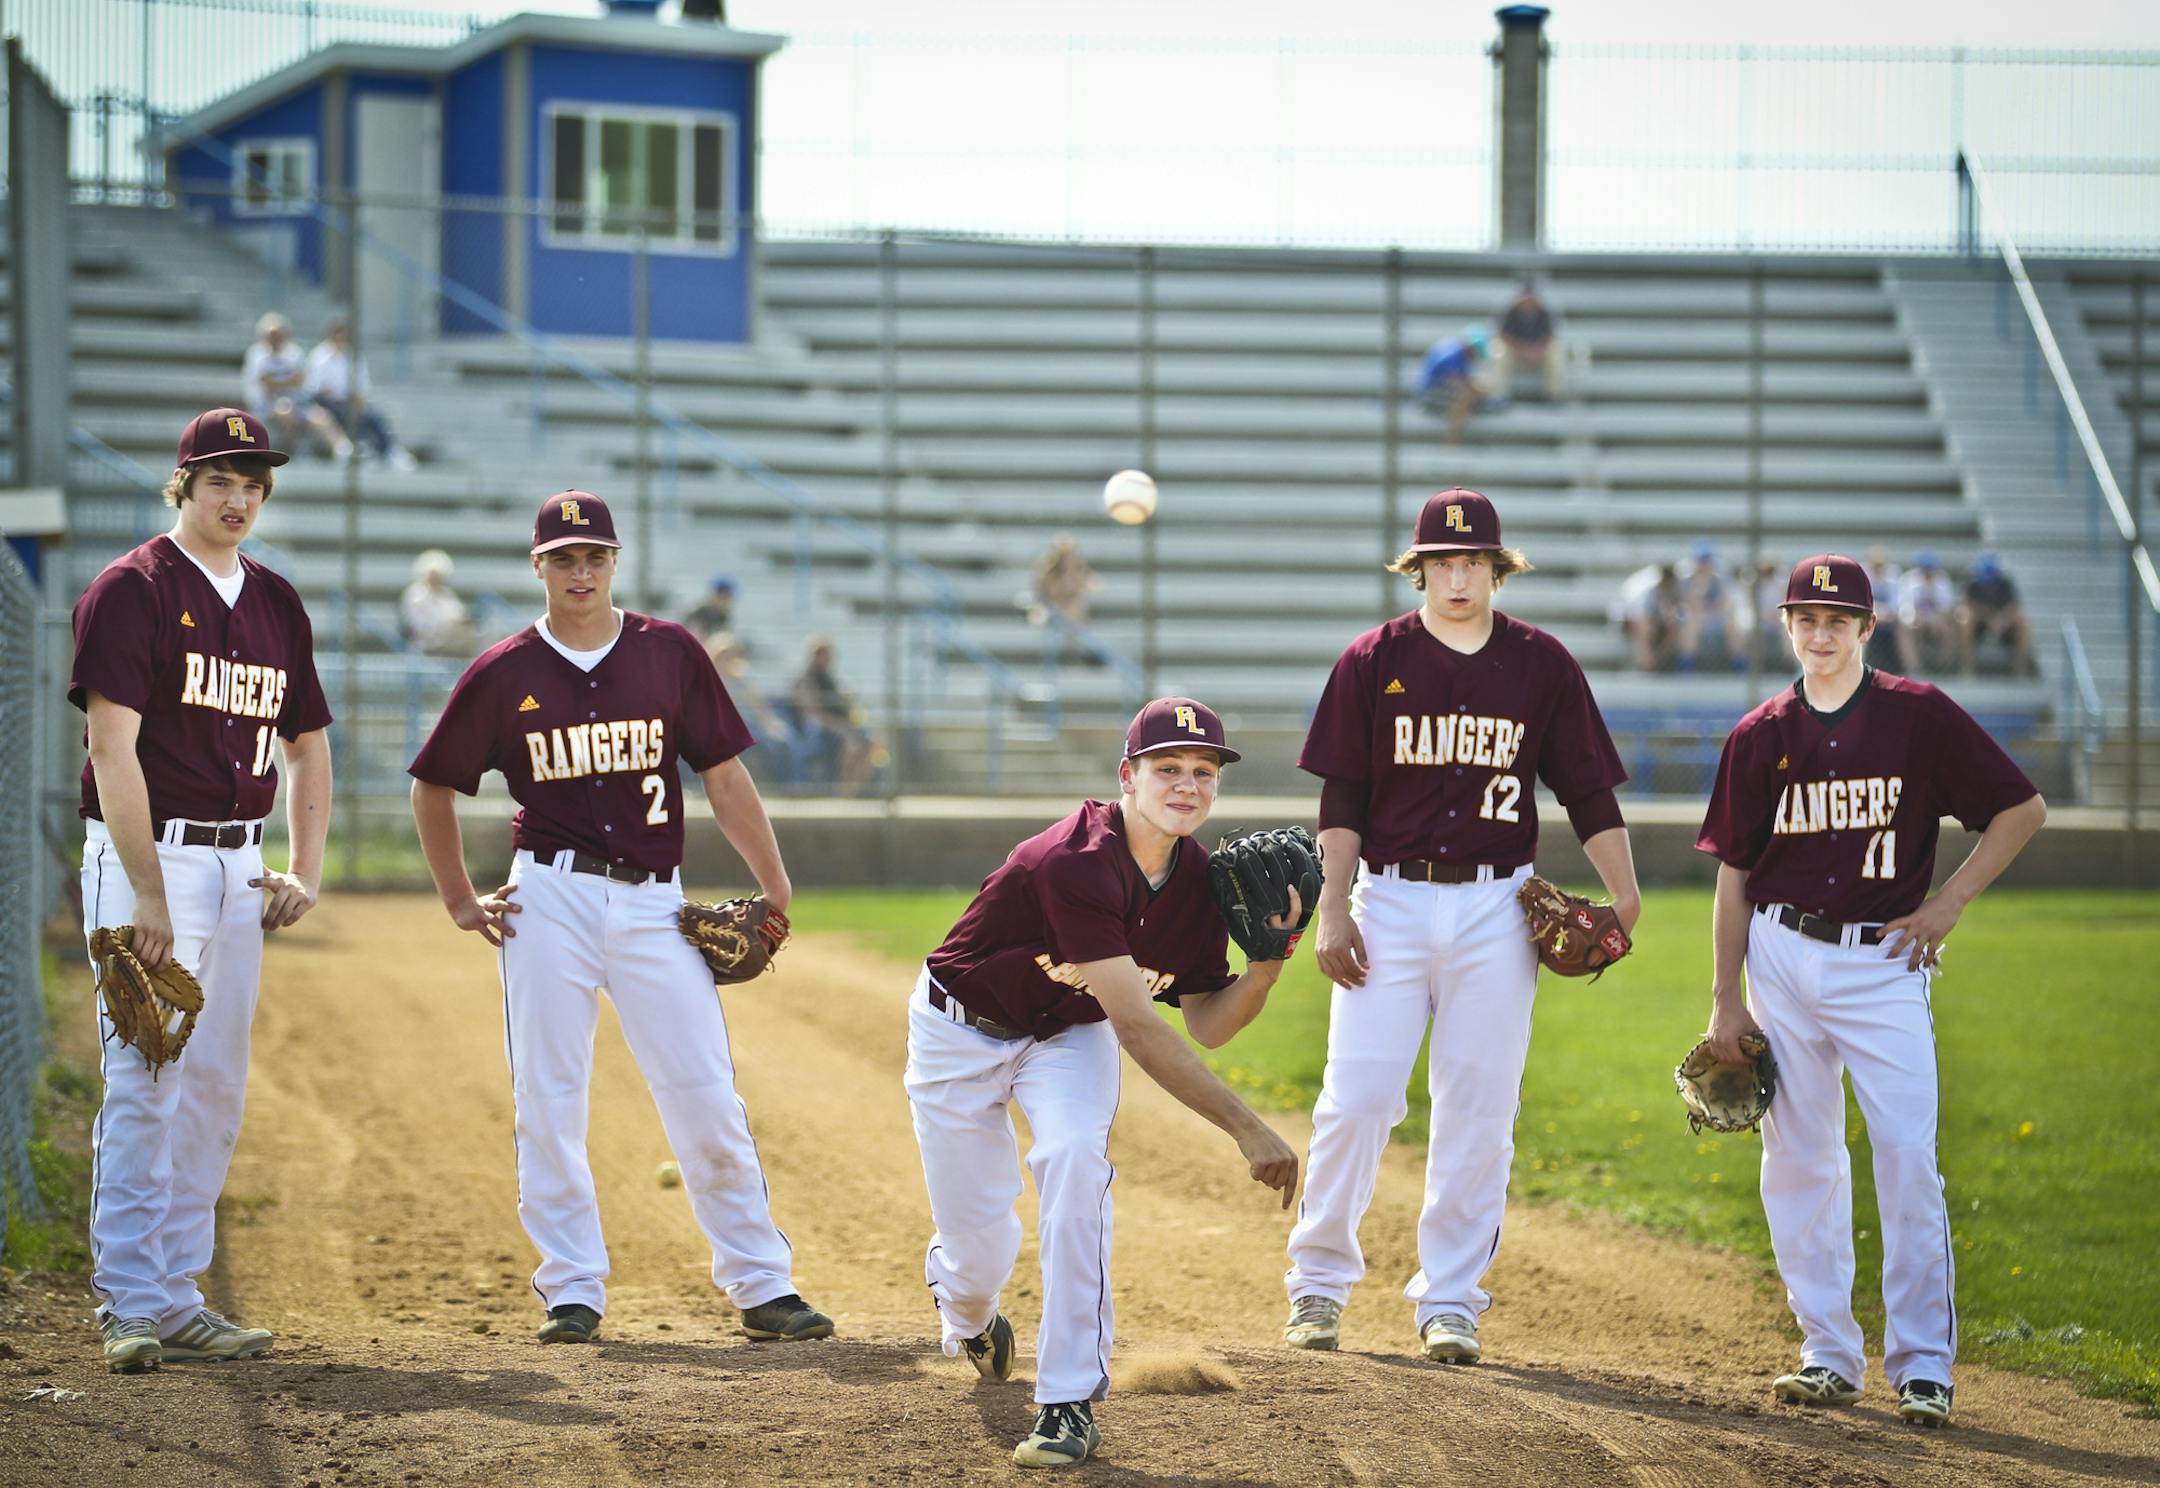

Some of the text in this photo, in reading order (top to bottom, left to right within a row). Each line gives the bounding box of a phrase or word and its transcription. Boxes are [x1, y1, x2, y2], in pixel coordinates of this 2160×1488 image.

[181, 652, 287, 719] RANGERS
[526, 719, 664, 782] RANGERS
[1394, 714, 1525, 768] RANGERS
[642, 774, 668, 826] 2
[1479, 774, 1523, 823] 12
